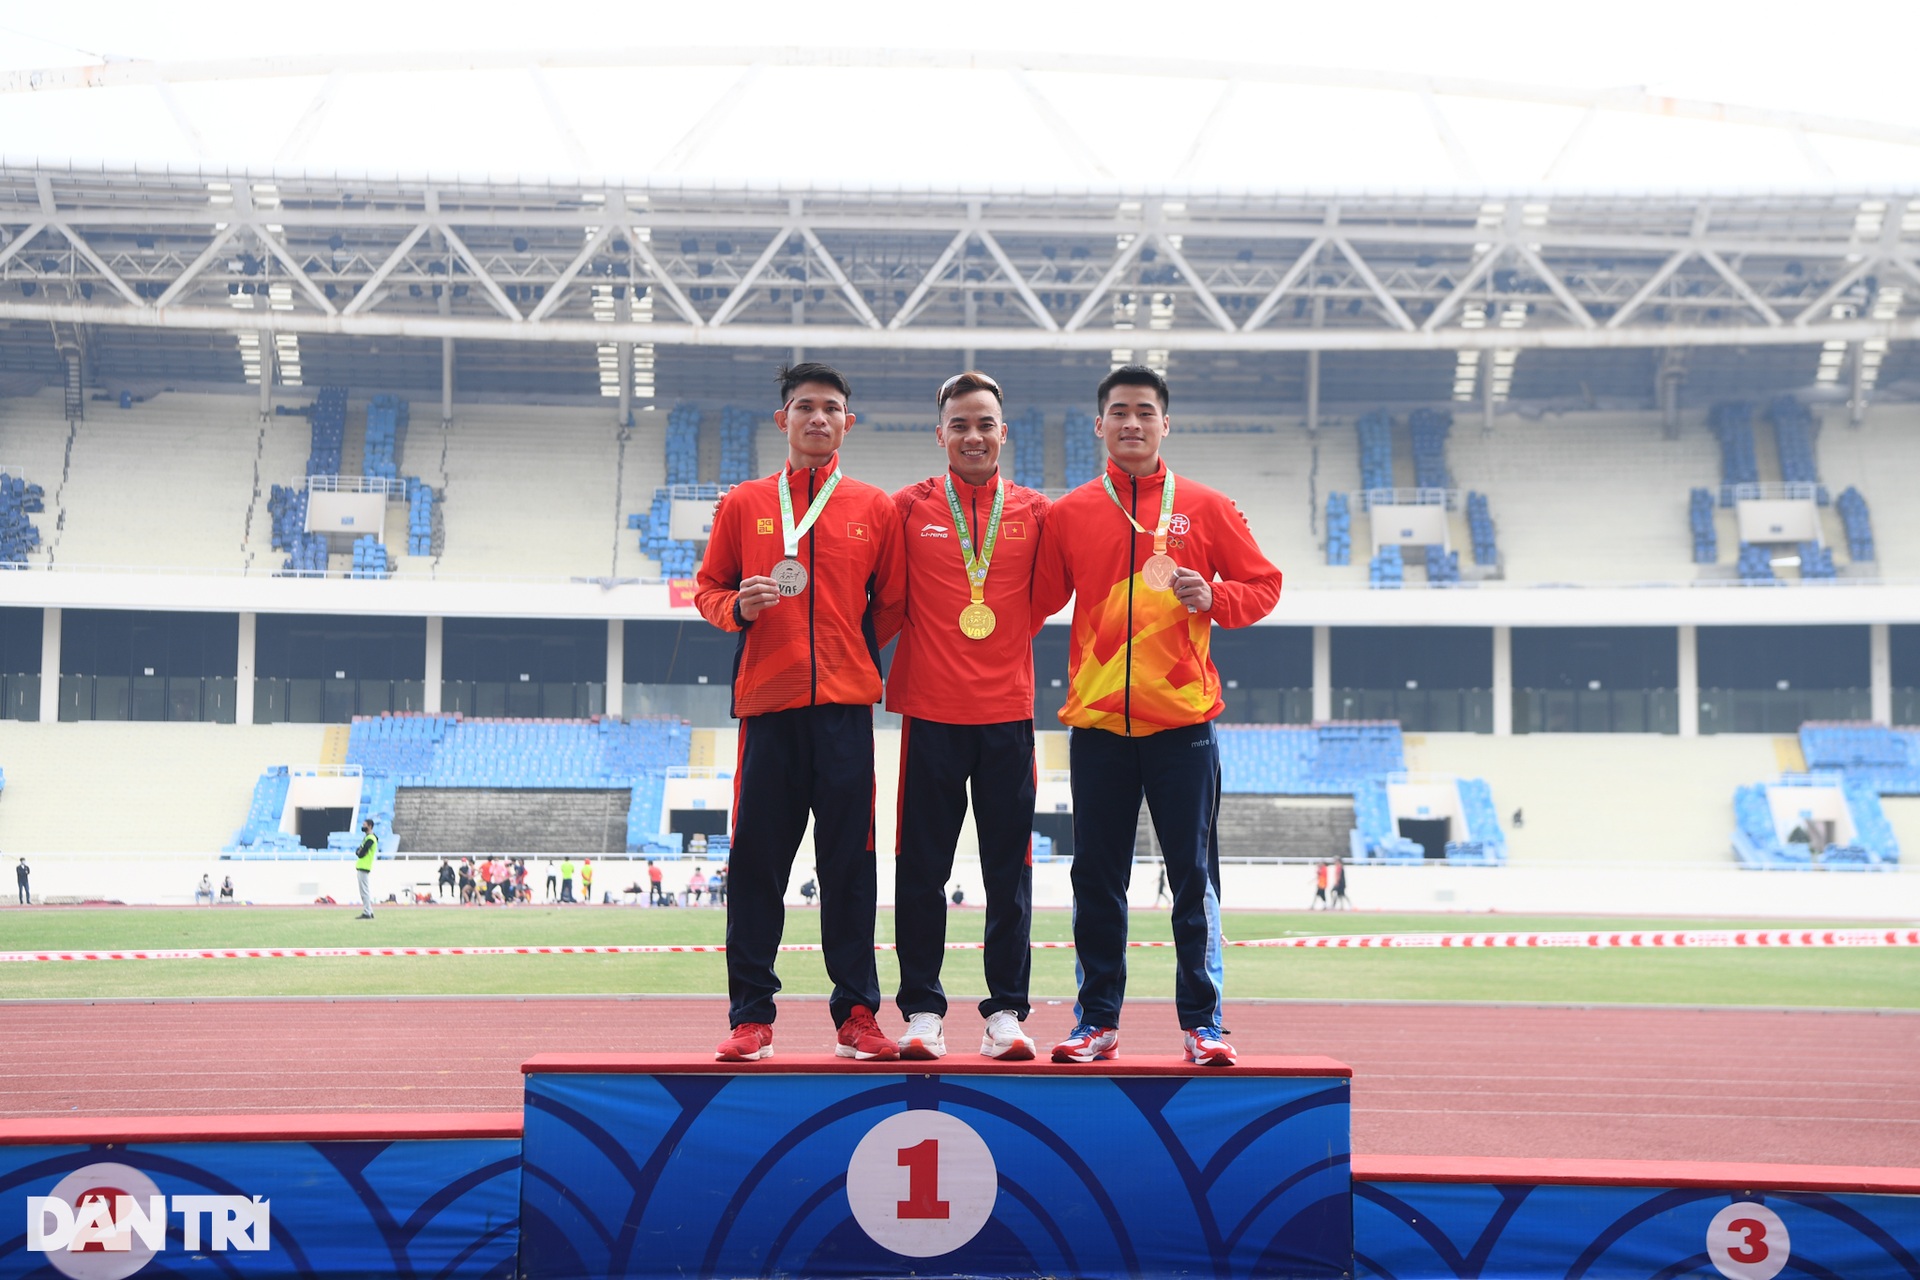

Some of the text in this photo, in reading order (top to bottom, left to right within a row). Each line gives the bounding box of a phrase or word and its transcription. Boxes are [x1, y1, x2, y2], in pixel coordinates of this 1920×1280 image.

[967, 627, 987, 637] VAF
[1191, 739, 1210, 748] mitre
[897, 1139, 950, 1219] 1
[1727, 1218, 1769, 1264] 3
